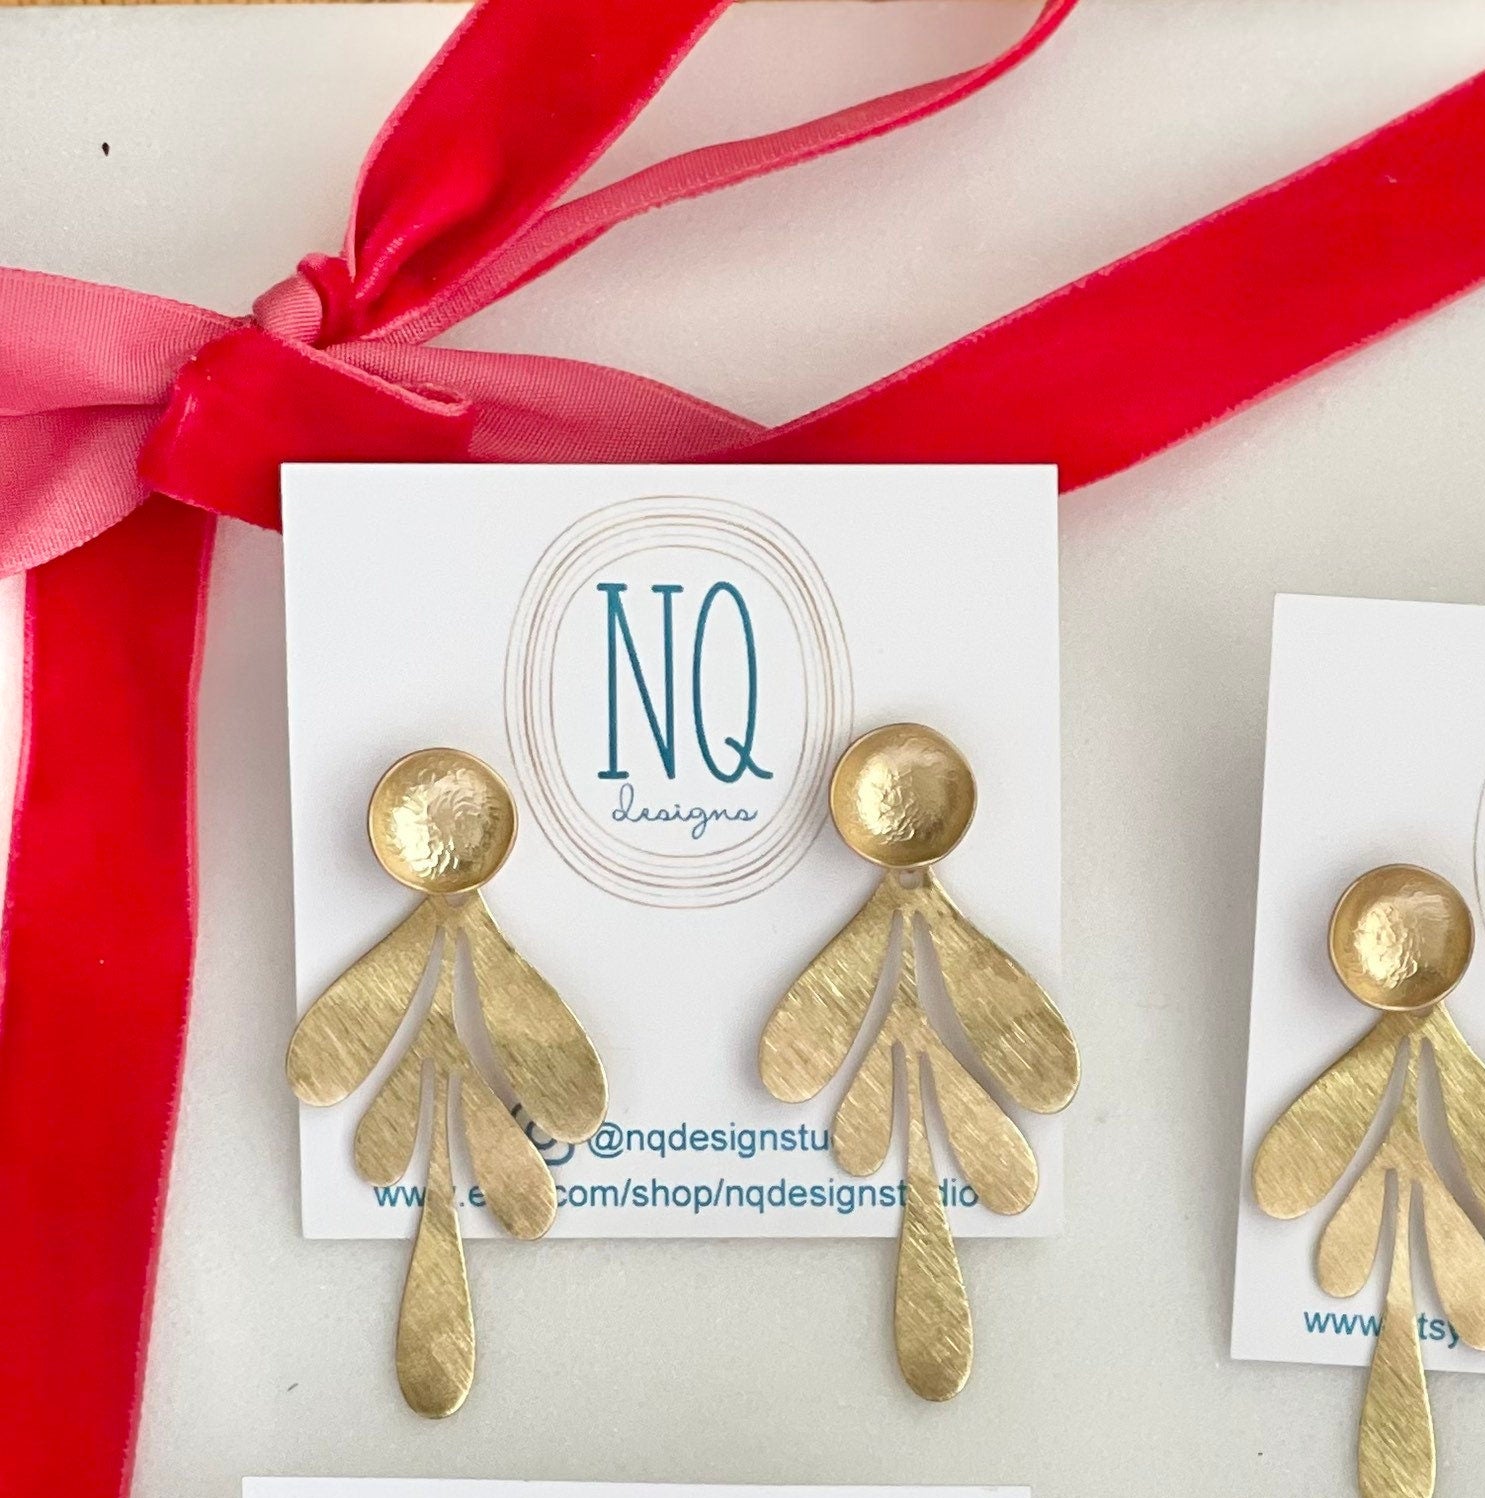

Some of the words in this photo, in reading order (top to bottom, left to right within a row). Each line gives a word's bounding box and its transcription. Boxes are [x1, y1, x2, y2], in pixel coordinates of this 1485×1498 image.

[596, 580, 773, 784] NQ
[612, 785, 758, 839] designs
[588, 1121, 832, 1160] @nqdesignstu
